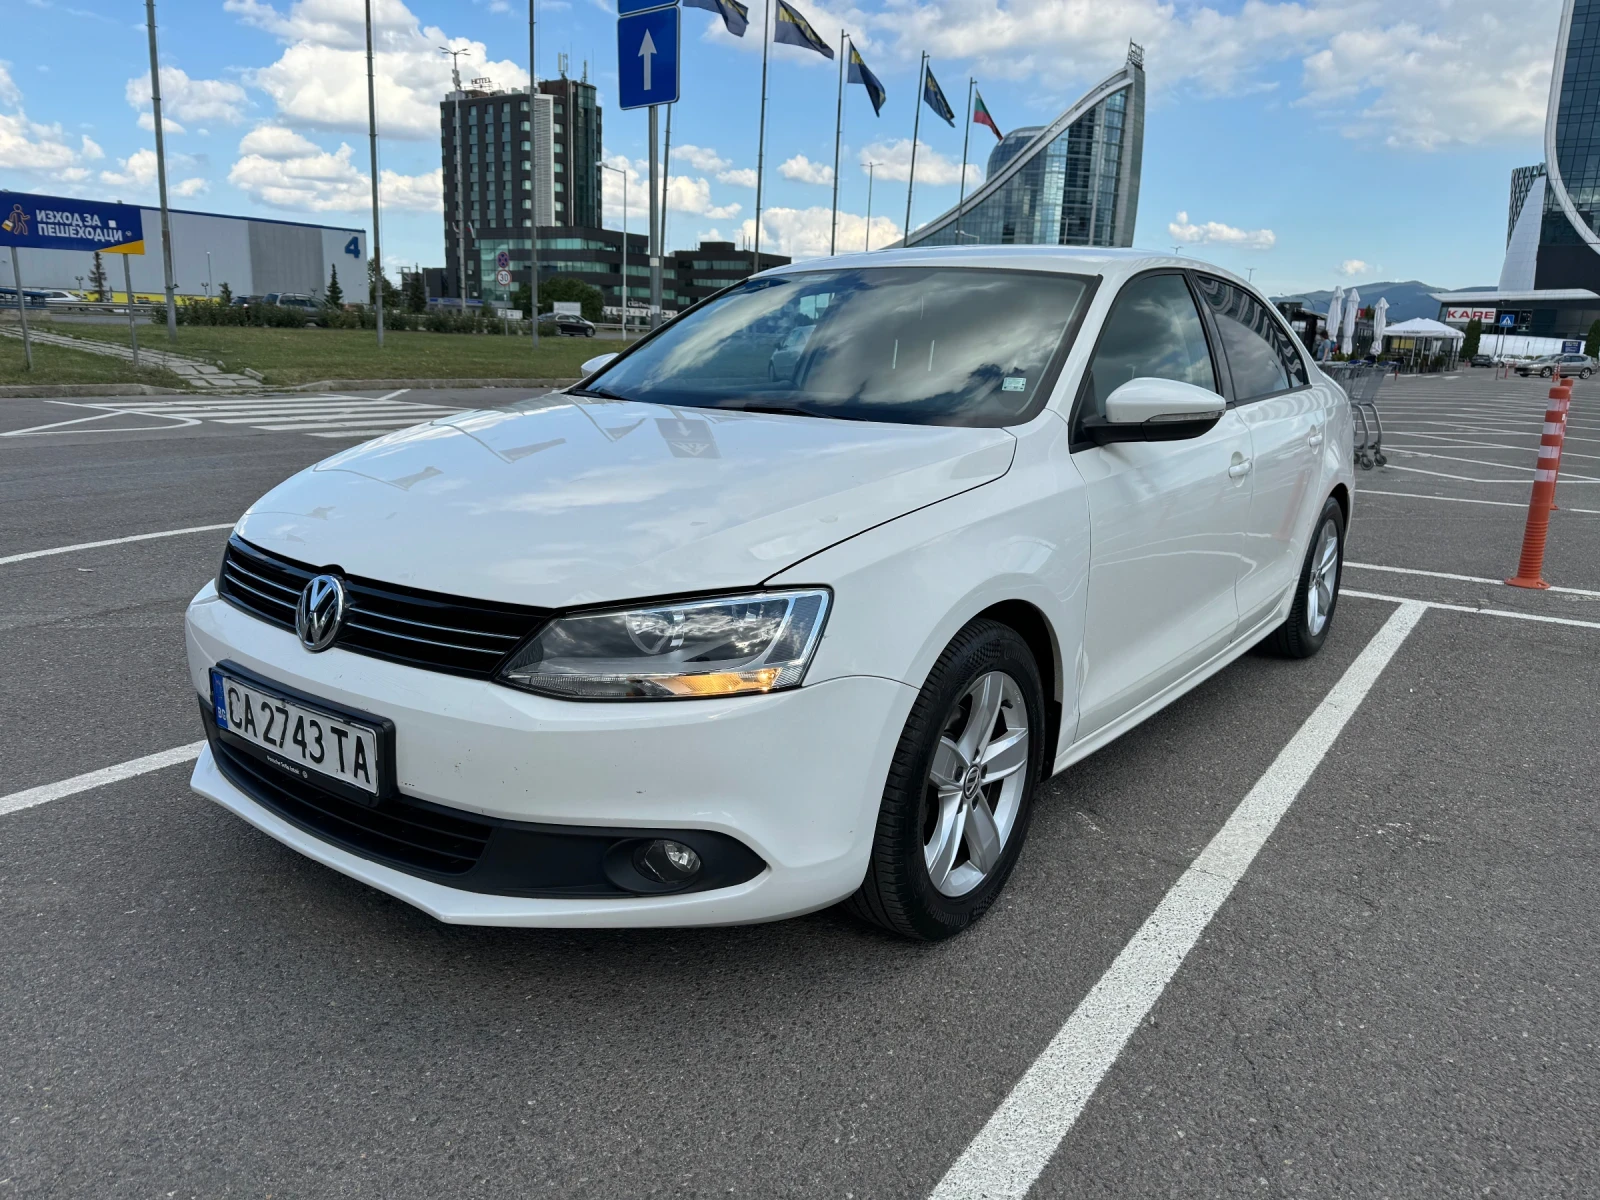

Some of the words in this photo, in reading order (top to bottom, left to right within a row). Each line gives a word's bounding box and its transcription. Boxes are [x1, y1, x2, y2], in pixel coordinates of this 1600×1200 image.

[36, 209, 83, 227] ИЗХОД
[83, 213, 102, 227] ЗА
[37, 223, 123, 243] ПЕШЕХОДЦИ
[344, 236, 361, 259] 4
[499, 273, 509, 282] 30
[1447, 310, 1495, 320] KARE
[217, 706, 227, 721] BG
